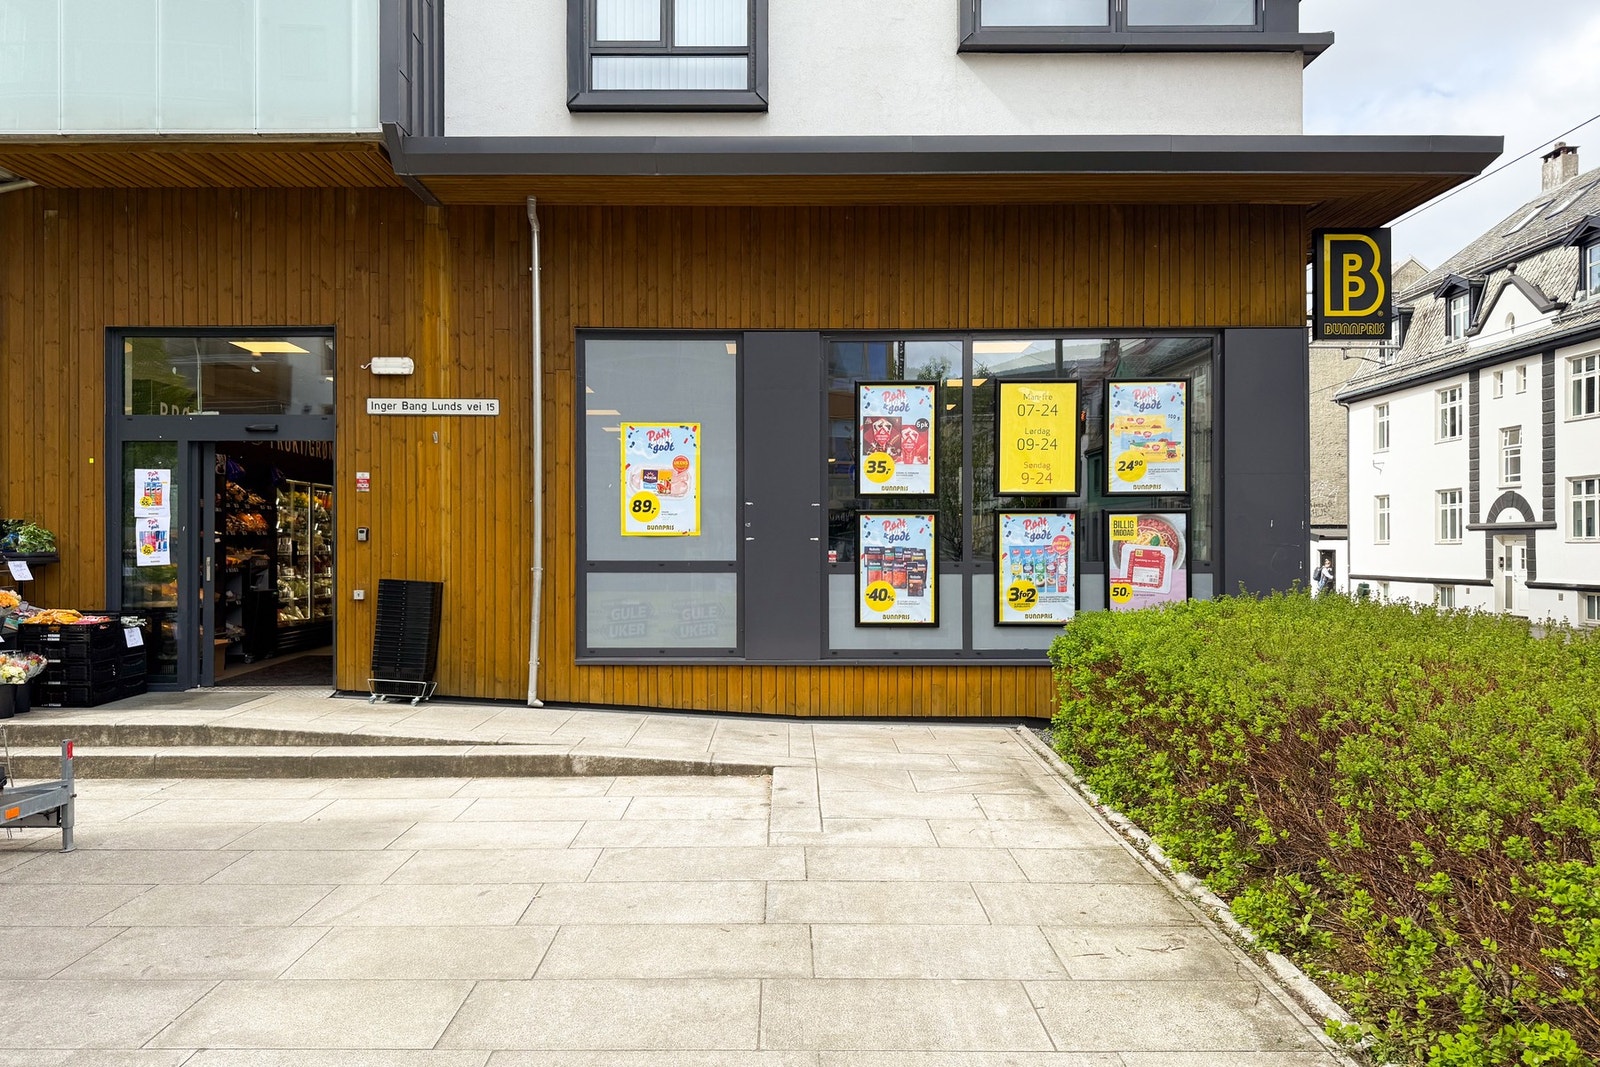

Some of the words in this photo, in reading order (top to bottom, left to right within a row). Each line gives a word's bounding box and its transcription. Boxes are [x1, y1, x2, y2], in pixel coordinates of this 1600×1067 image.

[1324, 322, 1384, 334] BUNNPRIS
[371, 401, 397, 412] Inger
[402, 401, 427, 412] Bang
[432, 402, 462, 411] Lunds
[467, 402, 482, 411] vei
[487, 403, 495, 412] 15
[888, 402, 910, 414] godt
[1017, 404, 1058, 416] 07-24
[1139, 400, 1162, 412] godt
[1024, 428, 1050, 436] Lørdag
[653, 442, 674, 454] godt
[1016, 438, 1058, 450] 09-24
[1024, 462, 1051, 470] Søndag
[1021, 472, 1053, 484] 9-24
[1114, 520, 1134, 528] BILLIG
[888, 531, 910, 543] godt
[1030, 530, 1052, 542] godt
[611, 606, 648, 620] GULE
[682, 606, 717, 620] GULE
[608, 623, 645, 637] UKER
[680, 623, 716, 637] UKER
